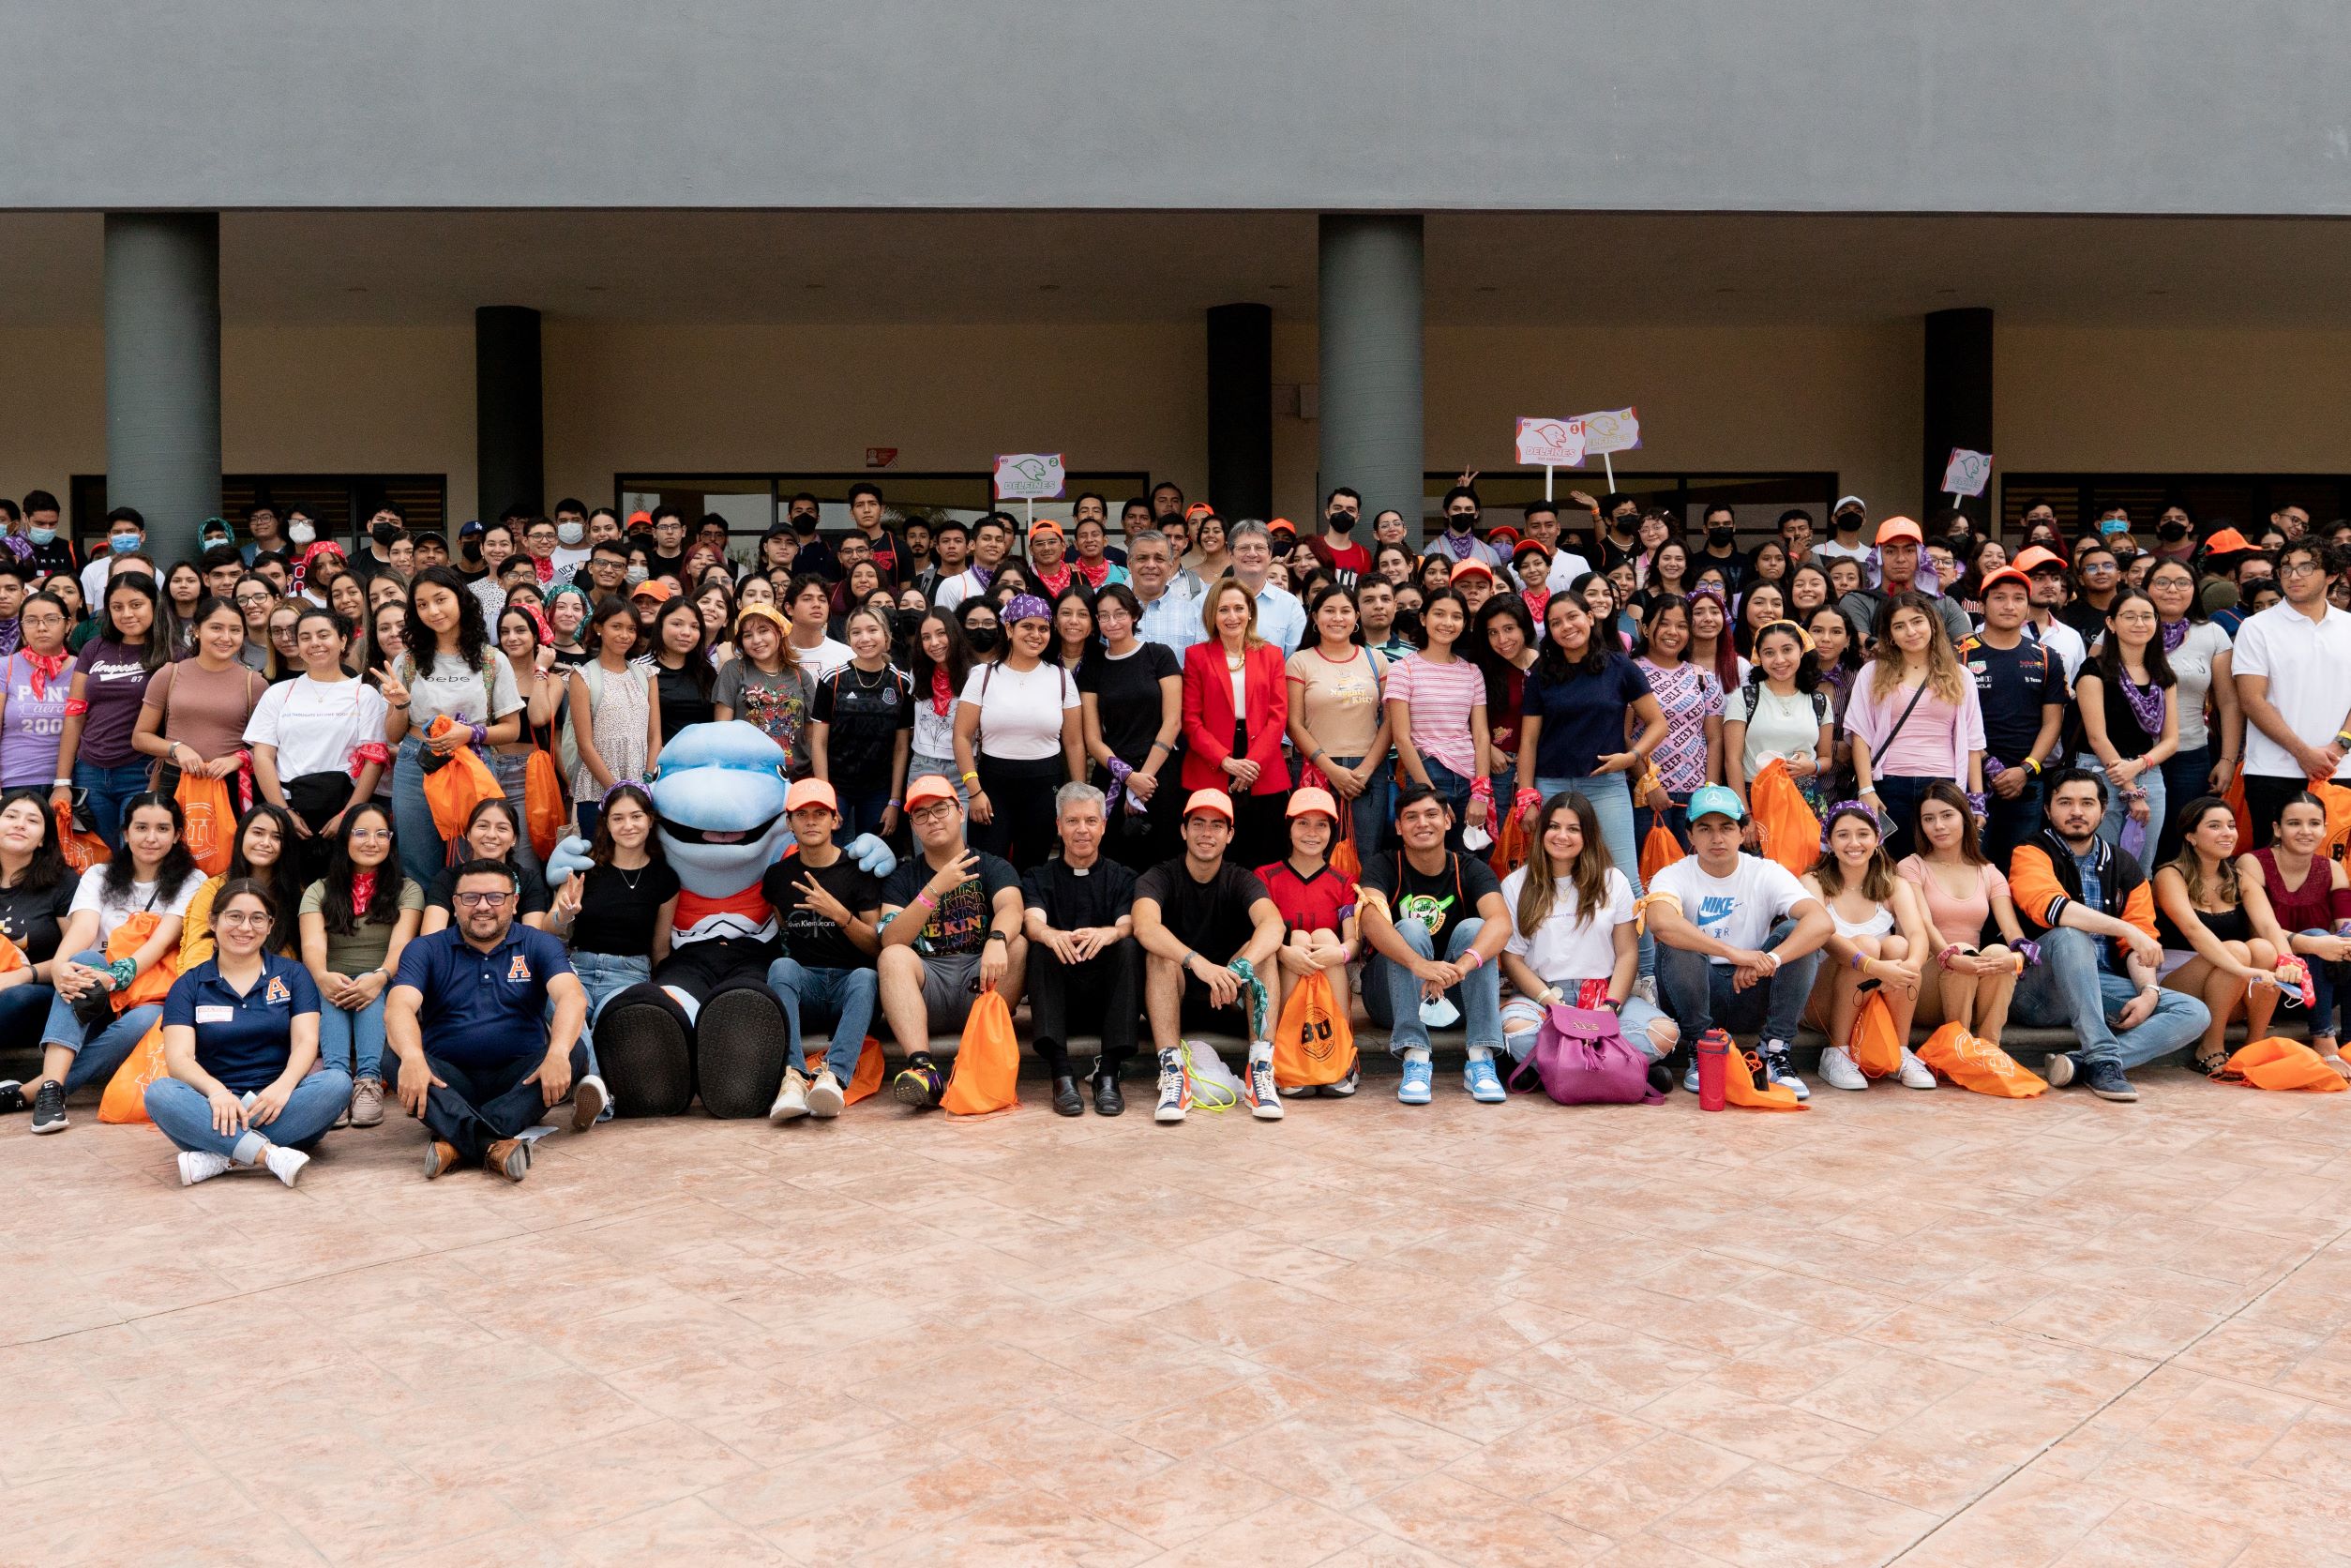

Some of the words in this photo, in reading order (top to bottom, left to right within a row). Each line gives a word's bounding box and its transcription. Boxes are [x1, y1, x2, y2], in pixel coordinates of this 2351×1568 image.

[1526, 445, 1575, 457] DELFINES
[1004, 481, 1056, 490] DELFINES
[1648, 671, 1662, 685] EEP
[1661, 686, 1682, 704] SELF
[1673, 727, 1694, 747] KEEP
[1660, 754, 1681, 774] KEEP
[1671, 762, 1695, 781] COOL
[1682, 771, 1702, 791] SELF
[1700, 897, 1735, 913] NIKE
[508, 955, 531, 979] A
[265, 975, 291, 1002] A
